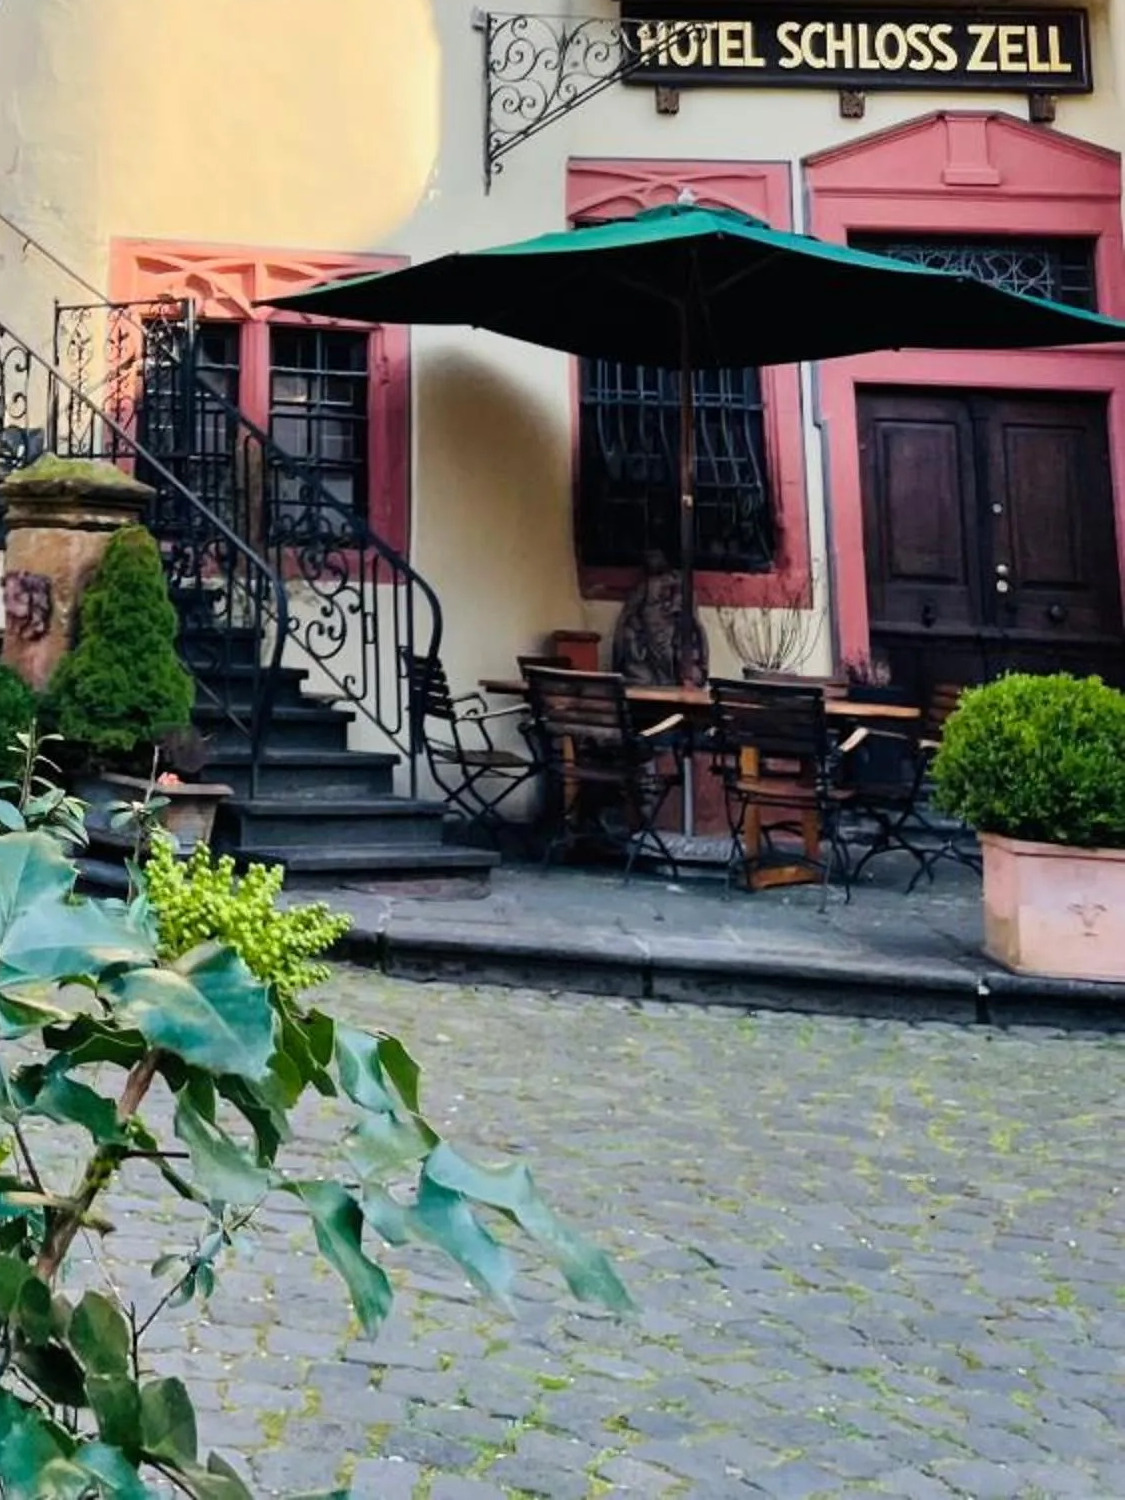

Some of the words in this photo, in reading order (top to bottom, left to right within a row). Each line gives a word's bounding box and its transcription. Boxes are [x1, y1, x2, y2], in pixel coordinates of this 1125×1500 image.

[638, 21, 766, 67] HOTEL
[776, 21, 958, 71] SCHLOSS
[966, 24, 1073, 73] ZELL
